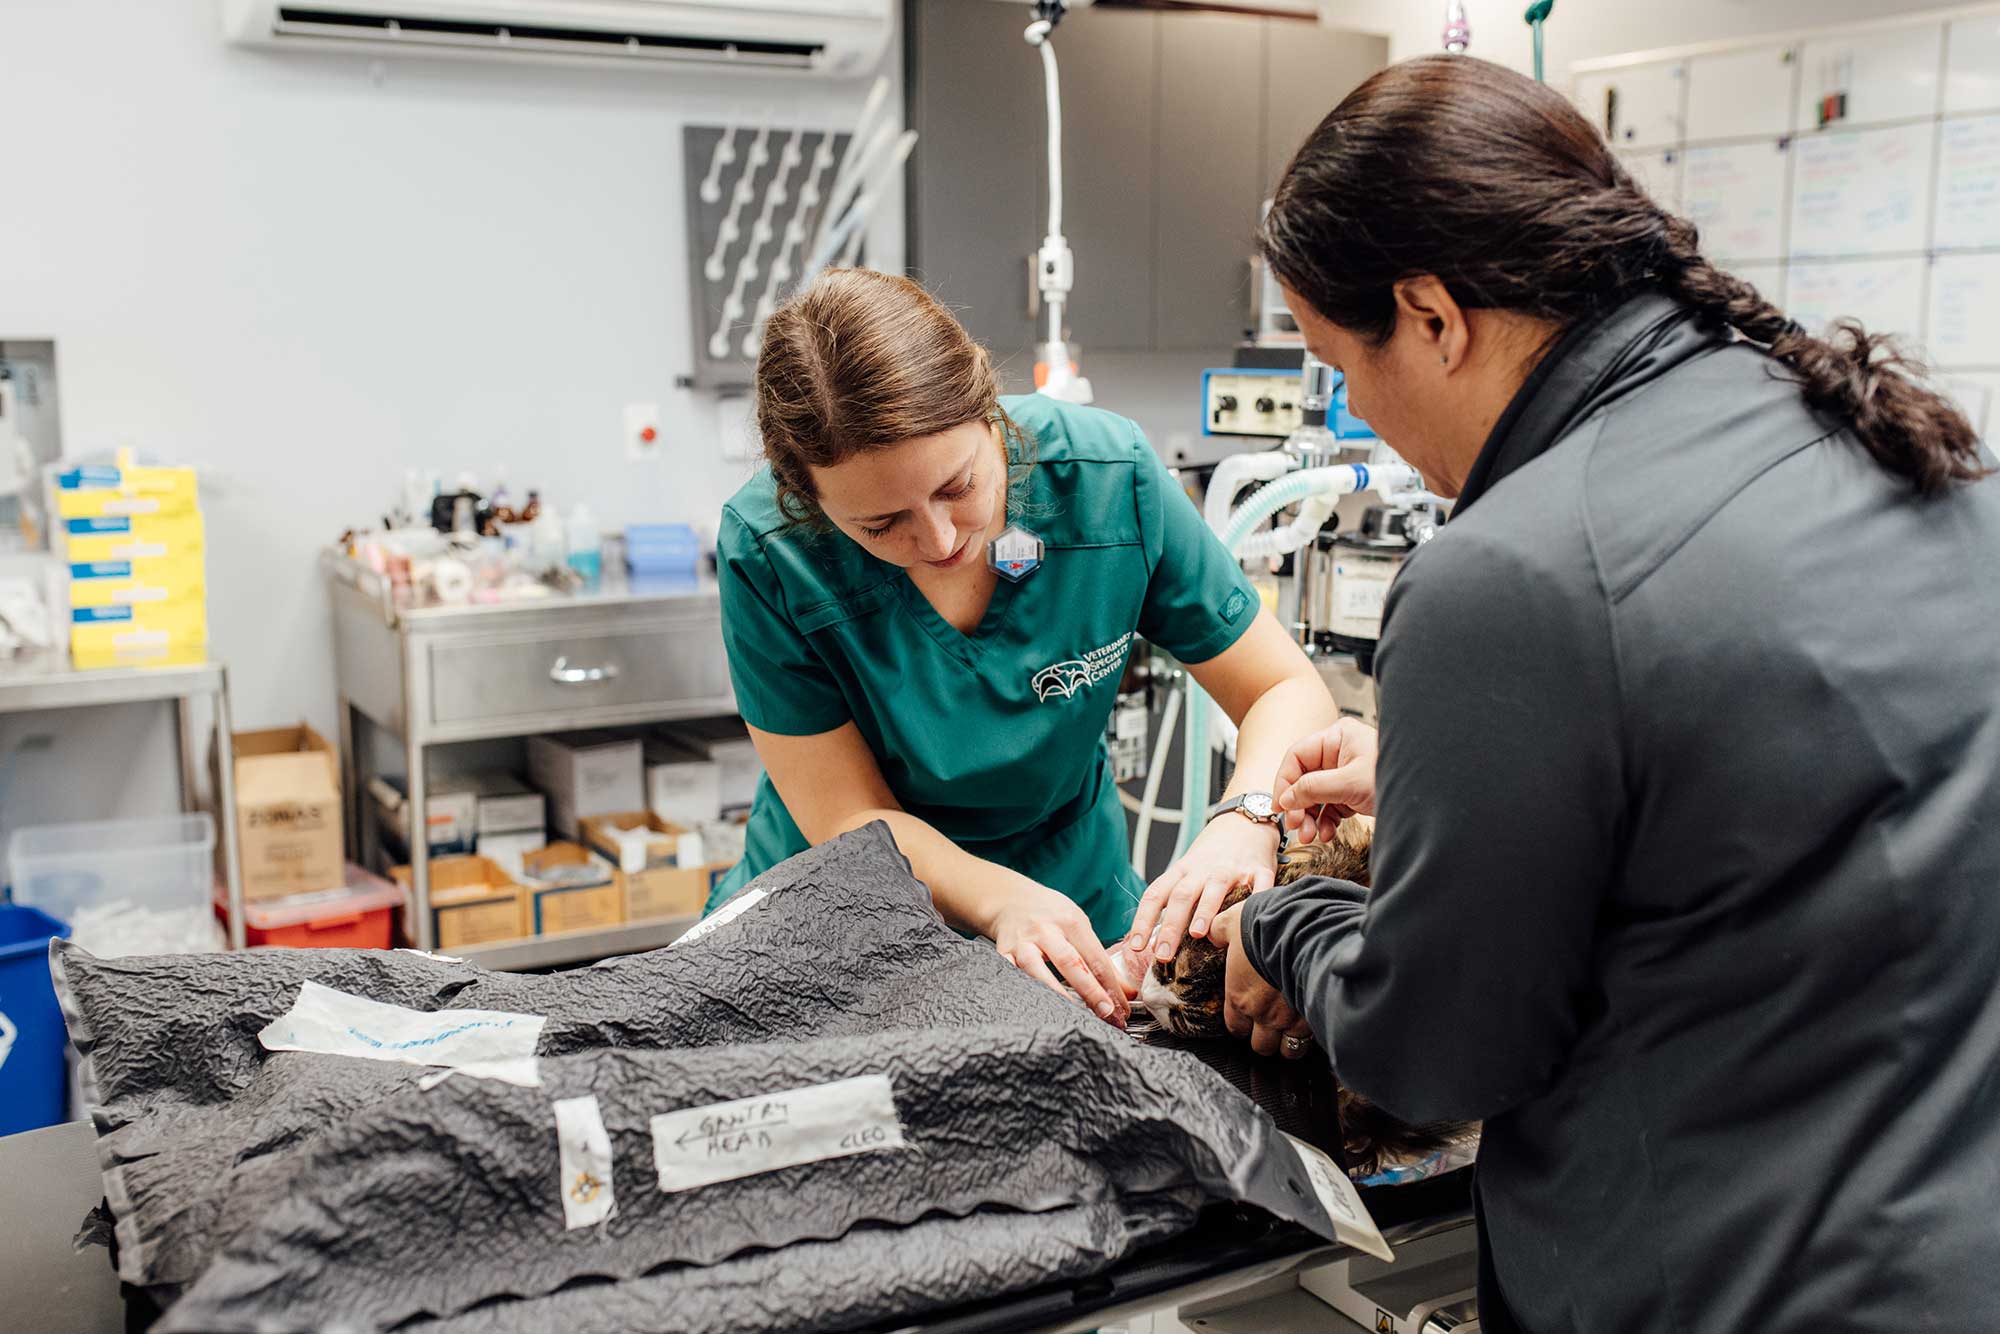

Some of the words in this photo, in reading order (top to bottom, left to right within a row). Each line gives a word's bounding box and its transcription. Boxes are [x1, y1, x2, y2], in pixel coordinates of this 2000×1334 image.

[1083, 631, 1131, 662] VETERINARY
[1090, 643, 1128, 671] SPECIALTY
[1091, 658, 1122, 682] CENTER
[707, 1131, 772, 1157] HEAD
[840, 1126, 885, 1149] CLEO
